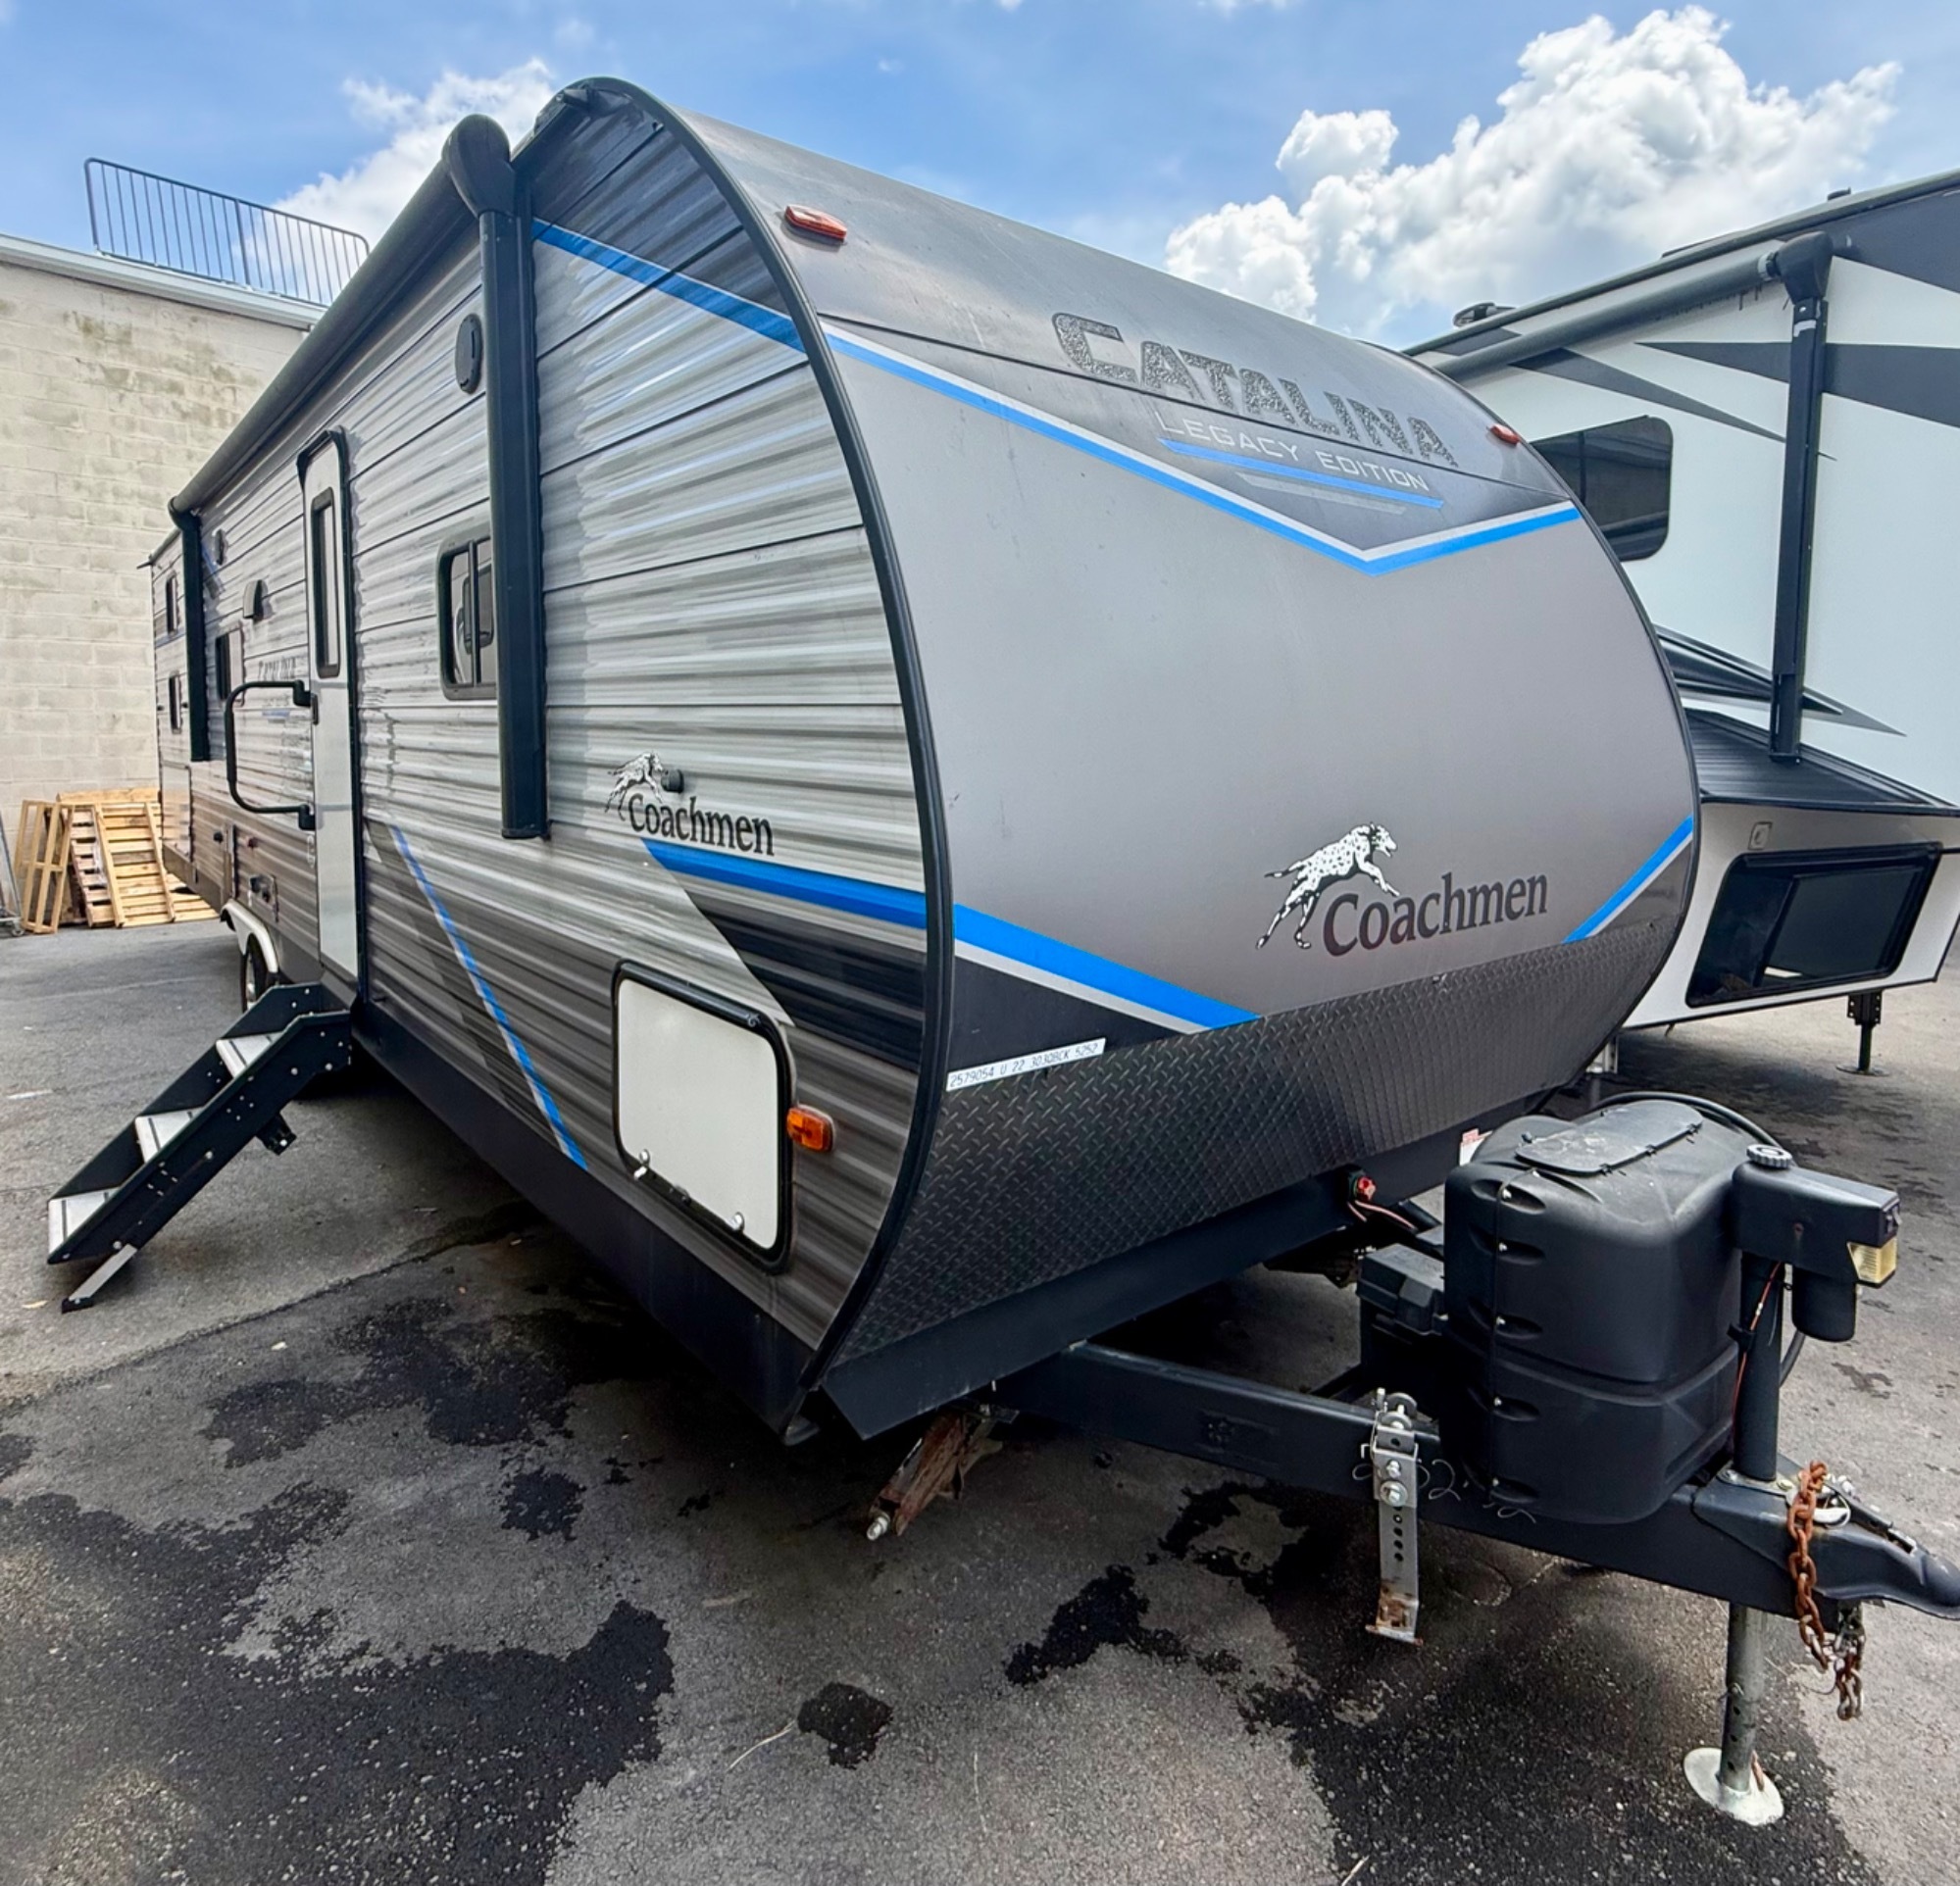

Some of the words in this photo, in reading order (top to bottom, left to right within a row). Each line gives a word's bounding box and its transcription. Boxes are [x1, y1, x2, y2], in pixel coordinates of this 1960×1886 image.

[1052, 312, 1459, 468] CATALINA
[1154, 410, 1300, 463] LEGACY
[1317, 452, 1431, 492] EDITION
[628, 792, 775, 857] Coachmen
[1323, 871, 1548, 957] Coachmen
[1012, 1060, 1026, 1072] 22
